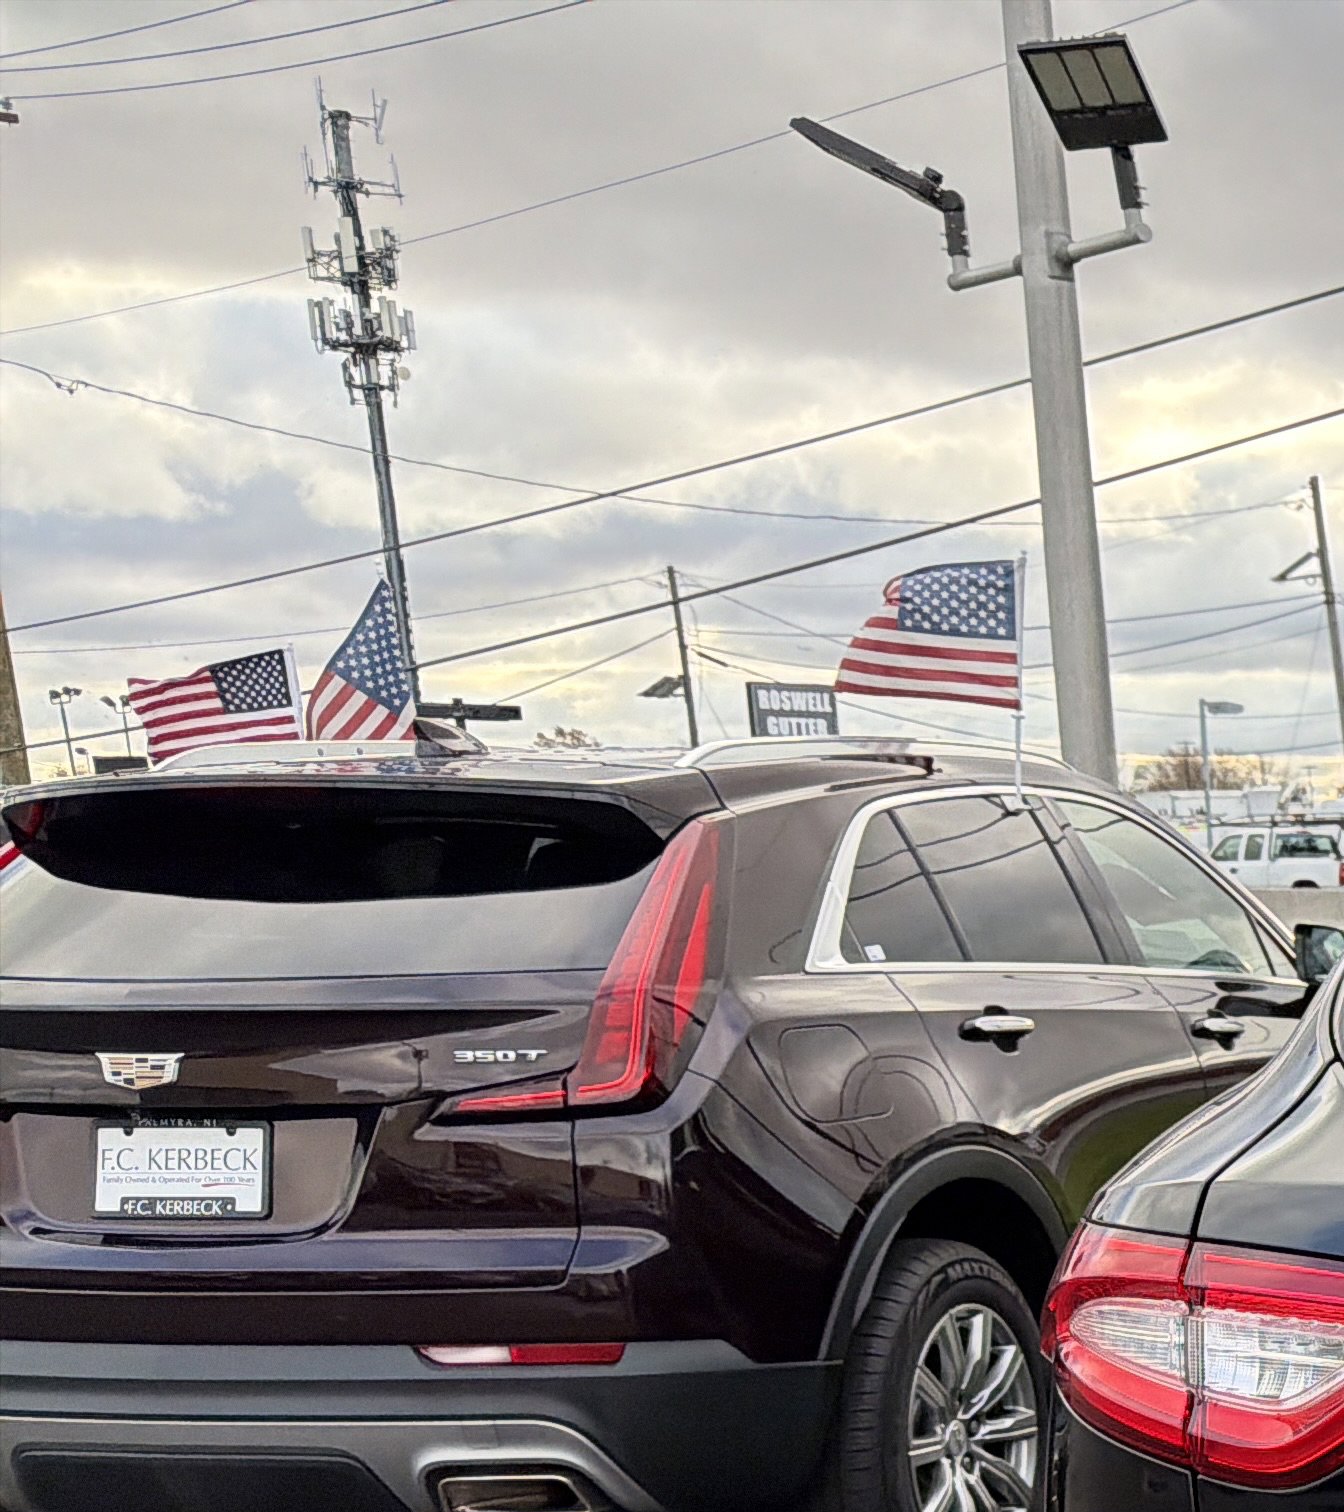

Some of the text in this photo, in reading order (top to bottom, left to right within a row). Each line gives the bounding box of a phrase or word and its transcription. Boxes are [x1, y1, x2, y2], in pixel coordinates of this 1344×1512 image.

[453, 1049, 549, 1063] 350T
[101, 1147, 258, 1171] F.C. KERBECK
[103, 1176, 123, 1184] Family
[125, 1176, 149, 1184] Owned
[151, 1176, 157, 1184] &
[158, 1176, 190, 1185] Operated
[127, 1200, 222, 1215] F.C. KERBECK
